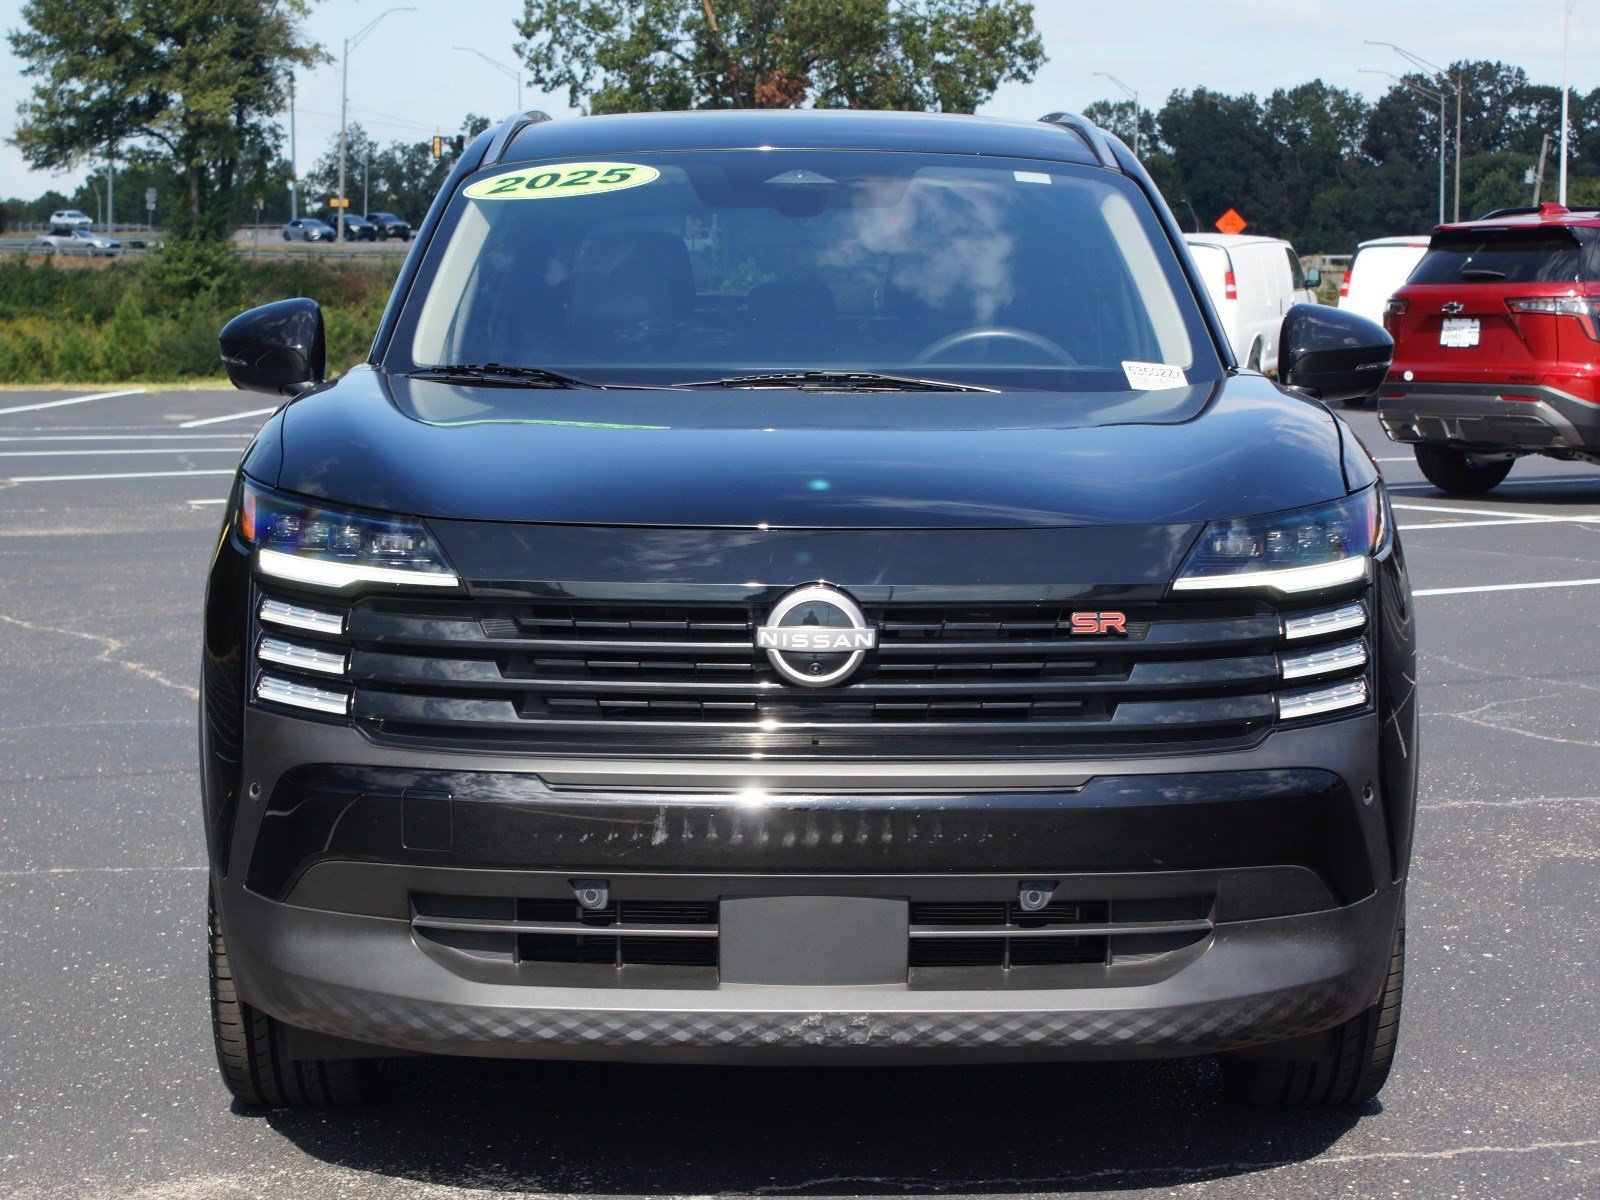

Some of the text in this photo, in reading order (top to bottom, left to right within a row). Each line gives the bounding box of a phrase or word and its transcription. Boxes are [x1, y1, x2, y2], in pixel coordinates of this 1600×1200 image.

[484, 167, 636, 195] 2025
[1071, 612, 1127, 633] SR
[759, 631, 873, 649] NISSAN
